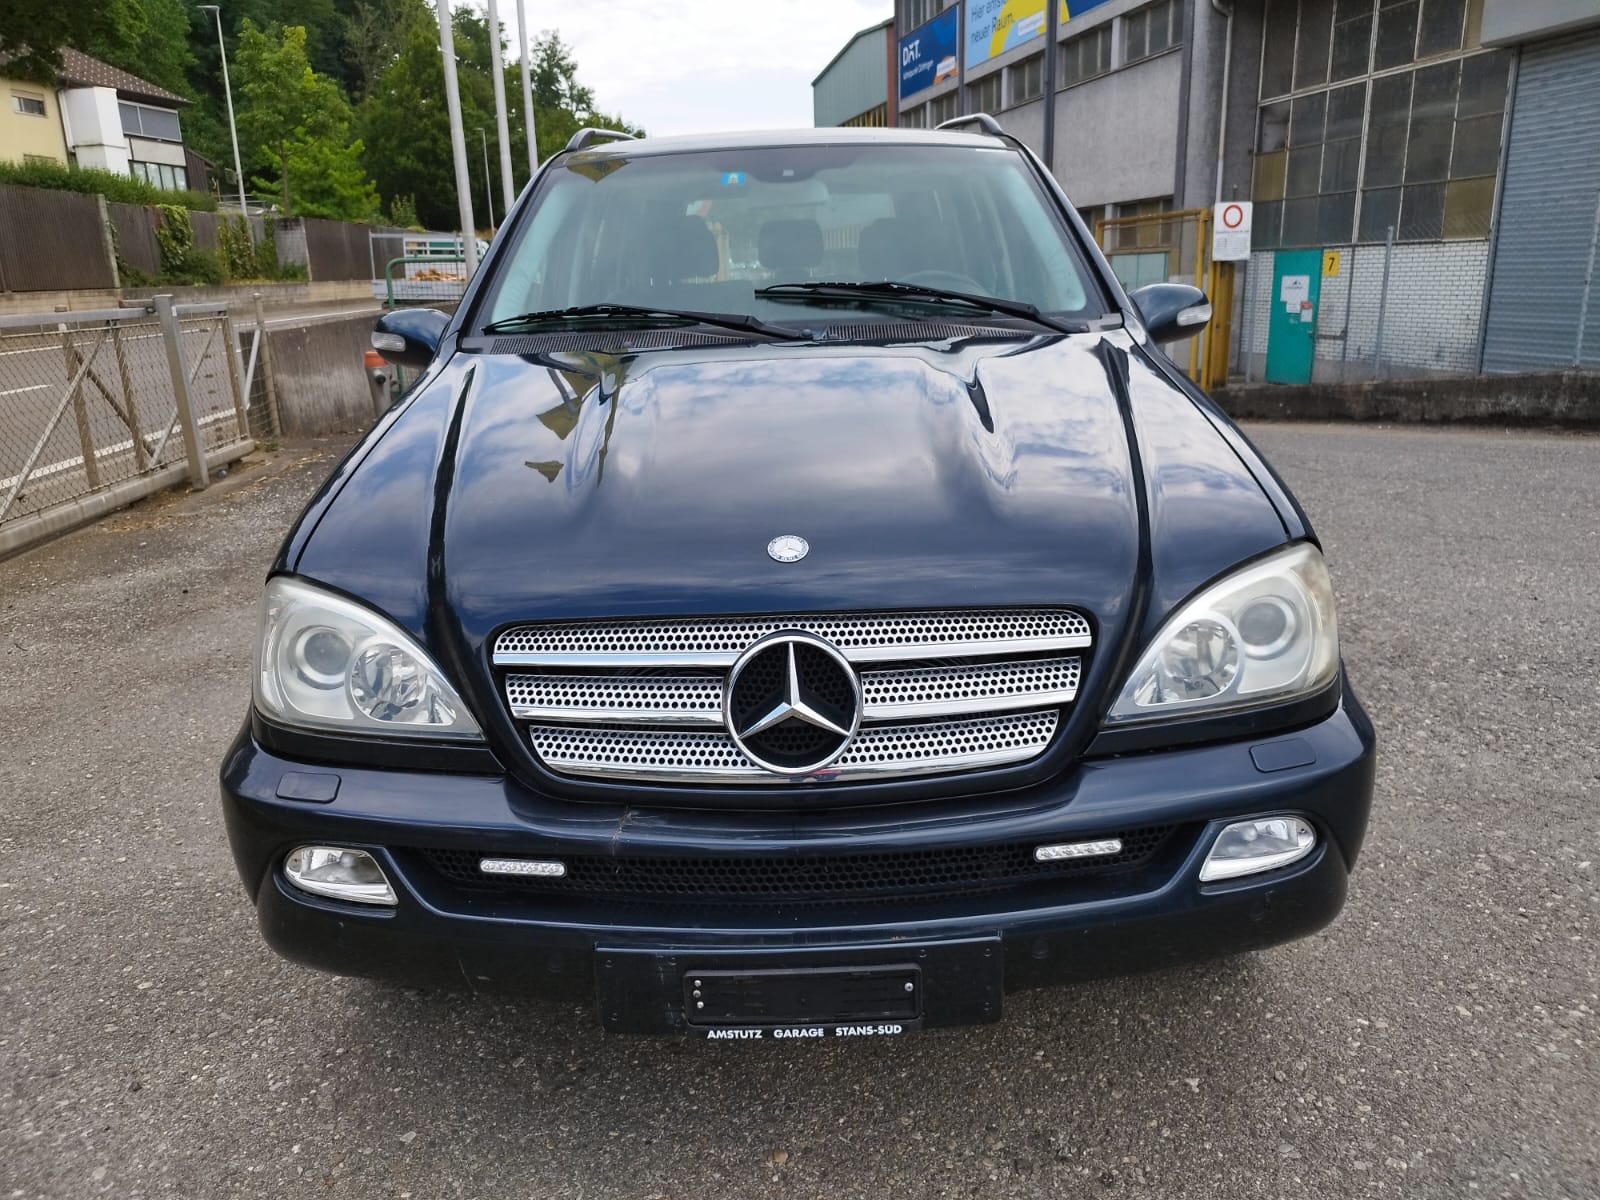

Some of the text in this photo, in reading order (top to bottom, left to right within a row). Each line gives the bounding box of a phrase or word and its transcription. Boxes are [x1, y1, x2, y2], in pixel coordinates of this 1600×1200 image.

[1328, 256, 1335, 272] 7
[707, 1024, 902, 1039] AMSTUTZ GARAGE STANS-SÜD
